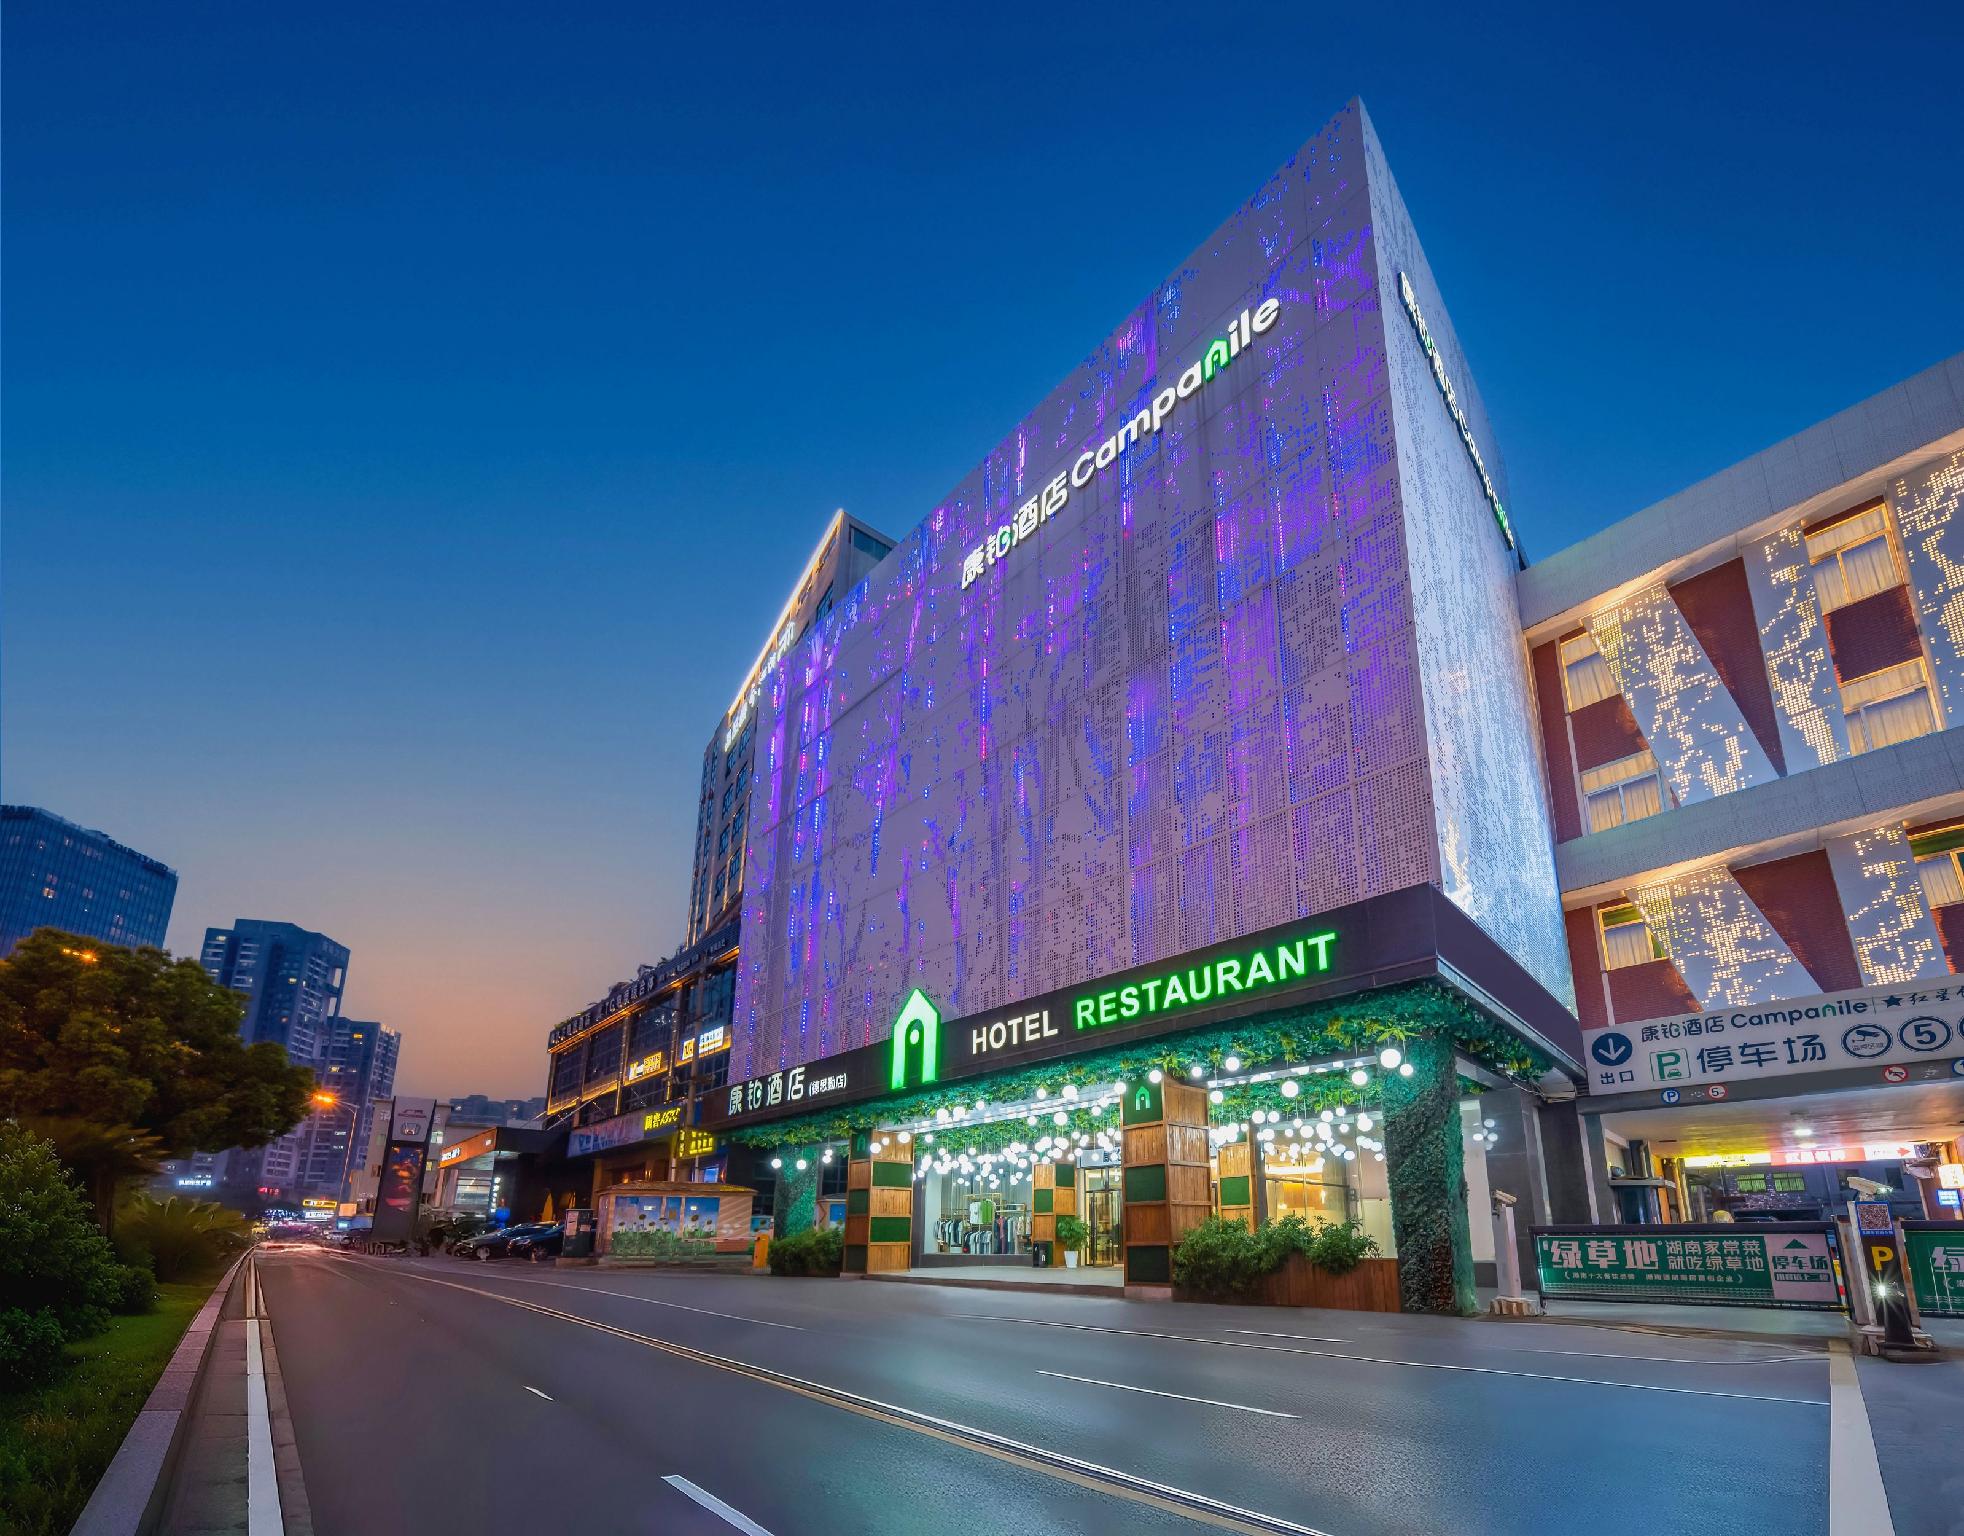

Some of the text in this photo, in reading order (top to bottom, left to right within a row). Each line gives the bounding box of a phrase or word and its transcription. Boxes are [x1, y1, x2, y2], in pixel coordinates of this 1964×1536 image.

[961, 297, 1280, 590] 康铂酒店 Campanile
[972, 932, 1337, 1055] HOTEL RESTAURANT
[1641, 999, 1868, 1043] 康铂酒店 Campanile
[1914, 1023, 1937, 1045] 5
[1656, 1052, 1681, 1080] P
[1697, 1033, 1826, 1073] 停车场
[728, 1067, 806, 1116] 康铂酒店
[1600, 1070, 1634, 1085] 出口
[1551, 1240, 1658, 1269] 绿草地
[1665, 1240, 1761, 1255] 湖南家常菜
[1871, 1246, 1894, 1271] P
[1666, 1255, 1765, 1271] 就吃绿草地
[1772, 1255, 1828, 1270] 停车场
